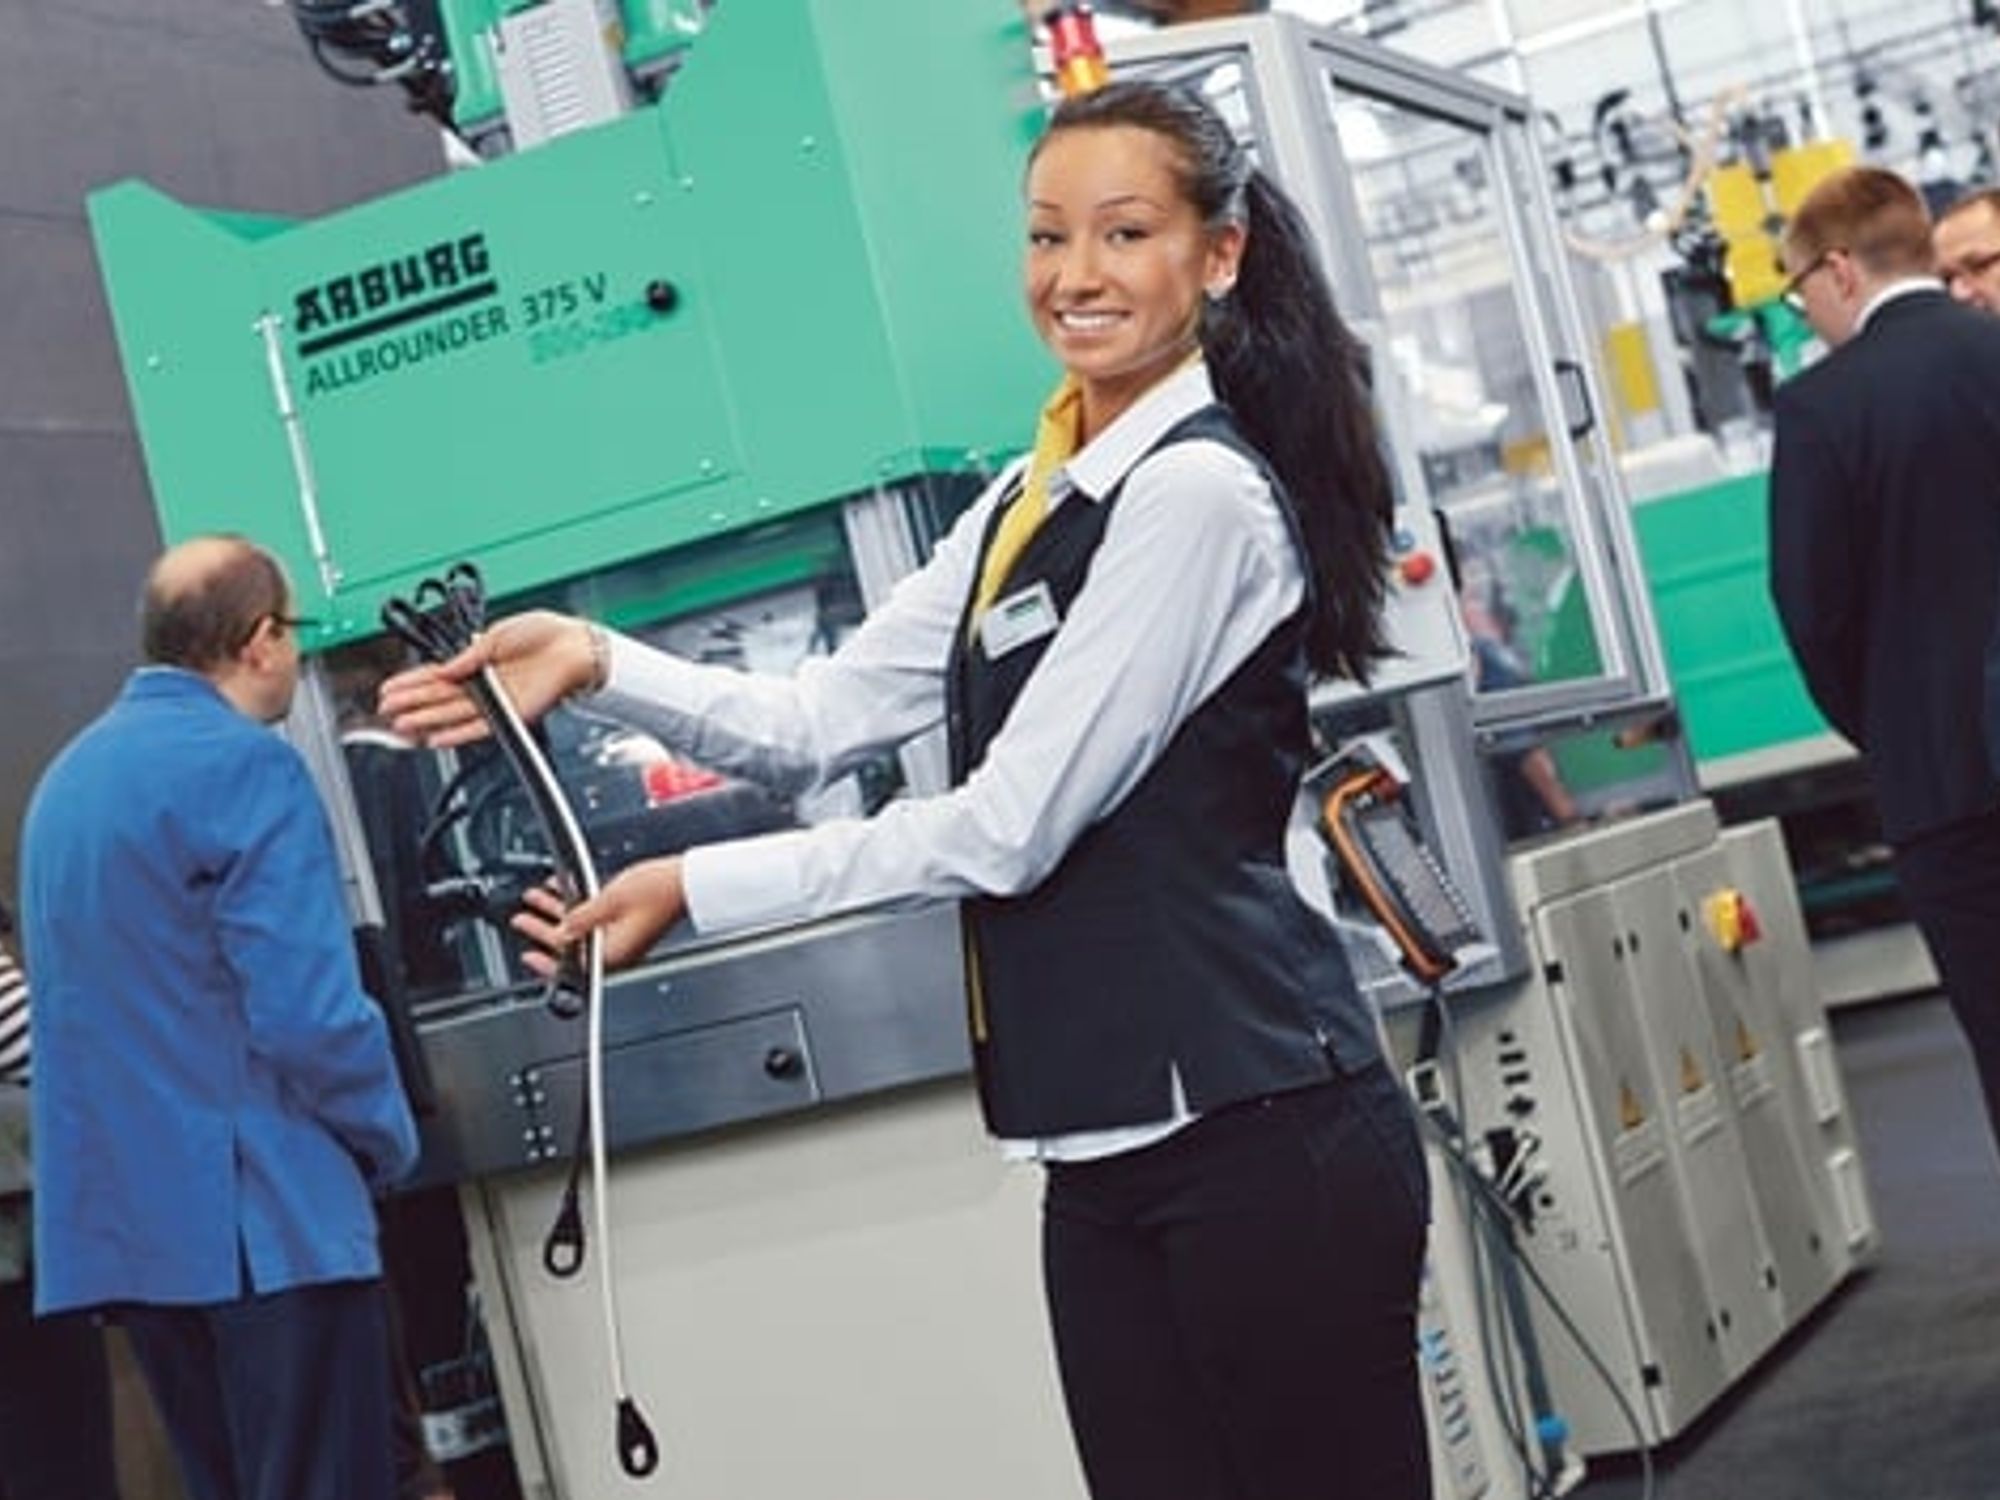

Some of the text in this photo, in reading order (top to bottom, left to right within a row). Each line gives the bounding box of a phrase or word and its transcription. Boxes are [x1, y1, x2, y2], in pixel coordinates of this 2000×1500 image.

[295, 233, 489, 333] ARBURG
[306, 306, 510, 397] ALLROUNDER
[521, 284, 579, 328] 375
[584, 273, 606, 302] V
